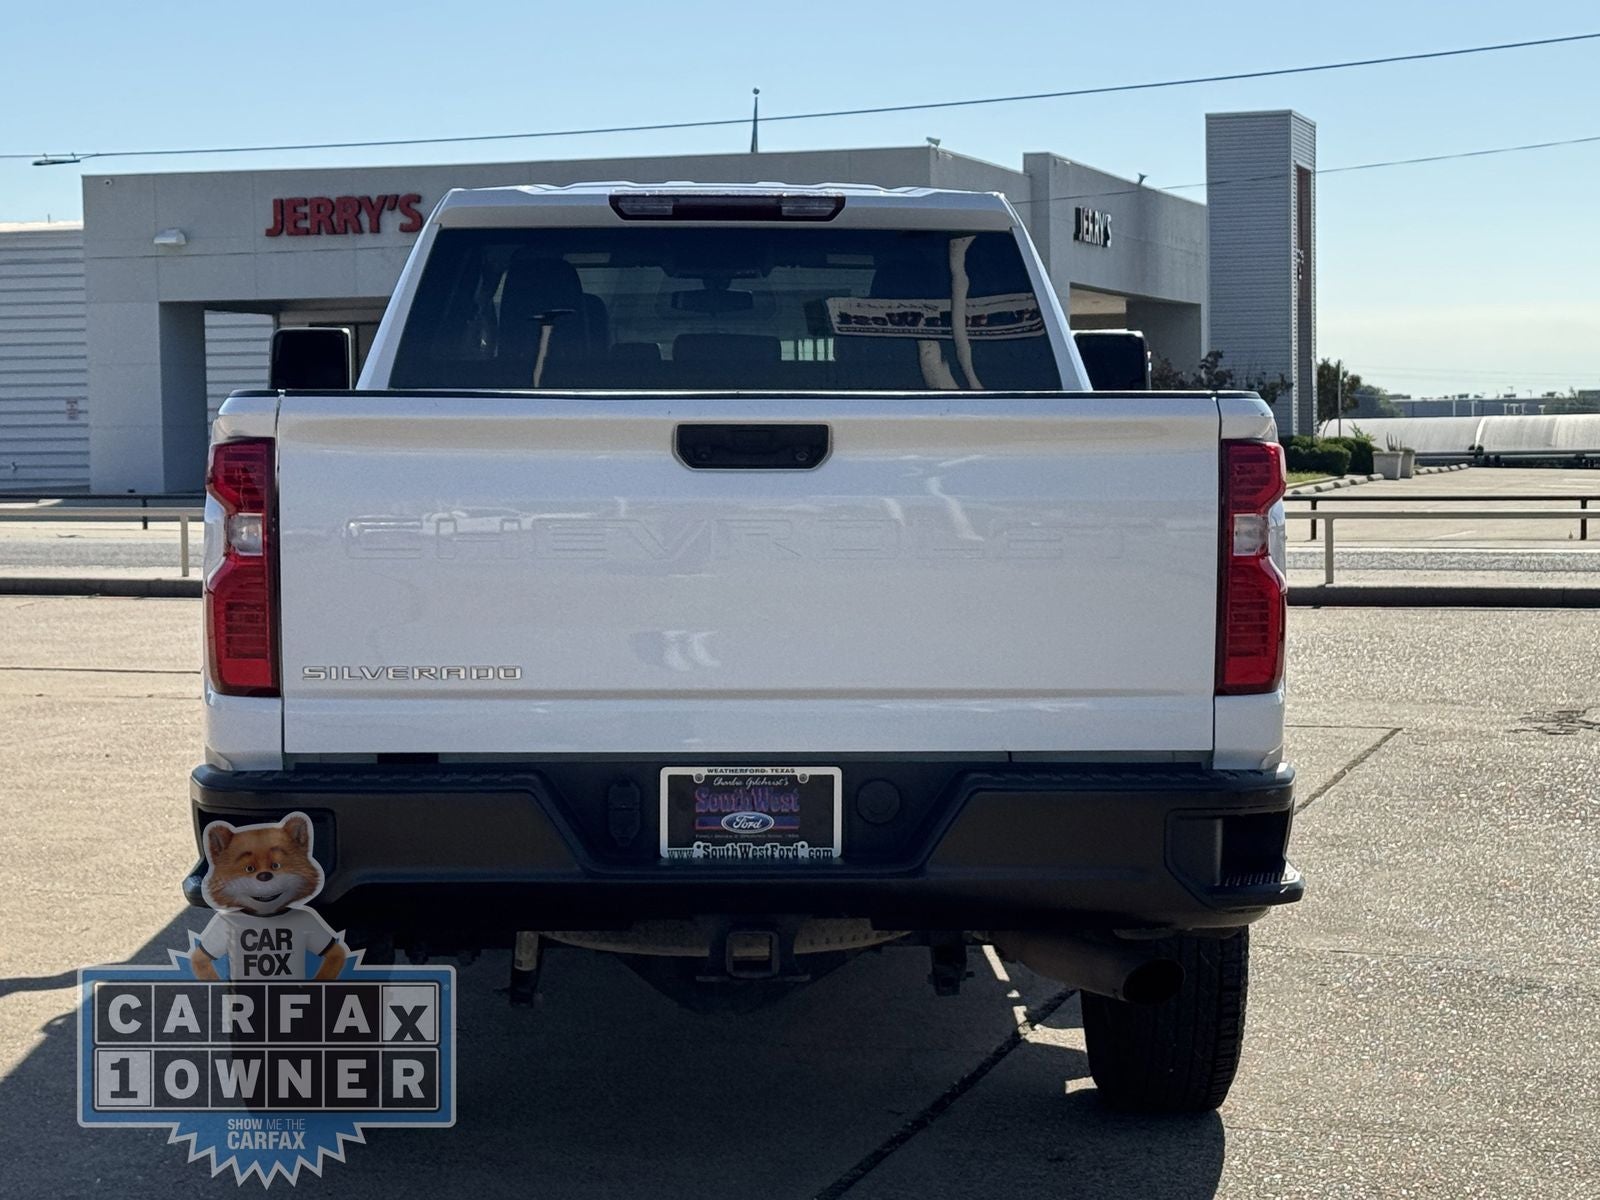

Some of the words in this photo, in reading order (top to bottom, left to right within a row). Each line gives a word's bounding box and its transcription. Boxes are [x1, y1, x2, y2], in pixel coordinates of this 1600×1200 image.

[265, 193, 423, 237] JERRY'S
[1073, 206, 1112, 248] JERRY'S
[345, 517, 1152, 560] CHEVROLET
[302, 665, 523, 680] SILVERADO
[695, 787, 799, 813] SouthWest
[732, 815, 763, 830] Ford
